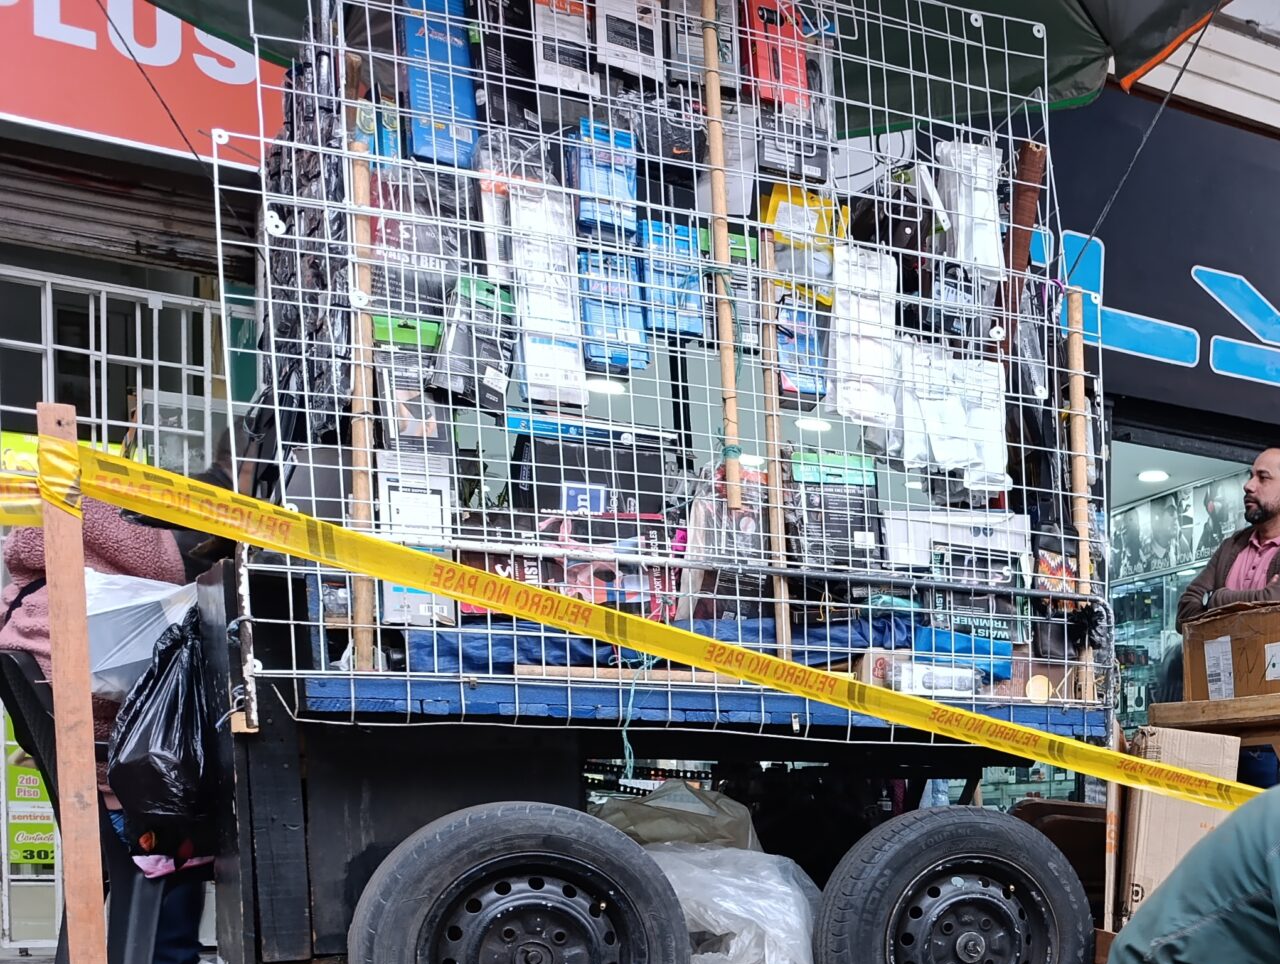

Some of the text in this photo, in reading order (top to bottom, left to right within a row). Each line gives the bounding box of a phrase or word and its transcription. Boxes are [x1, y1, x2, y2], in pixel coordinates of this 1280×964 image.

[0, 0, 257, 85] LUS
[952, 615, 1009, 629] TRIMMER
[969, 628, 1010, 640] WAIST
[18, 775, 39, 786] 2do
[16, 787, 40, 798] Piso
